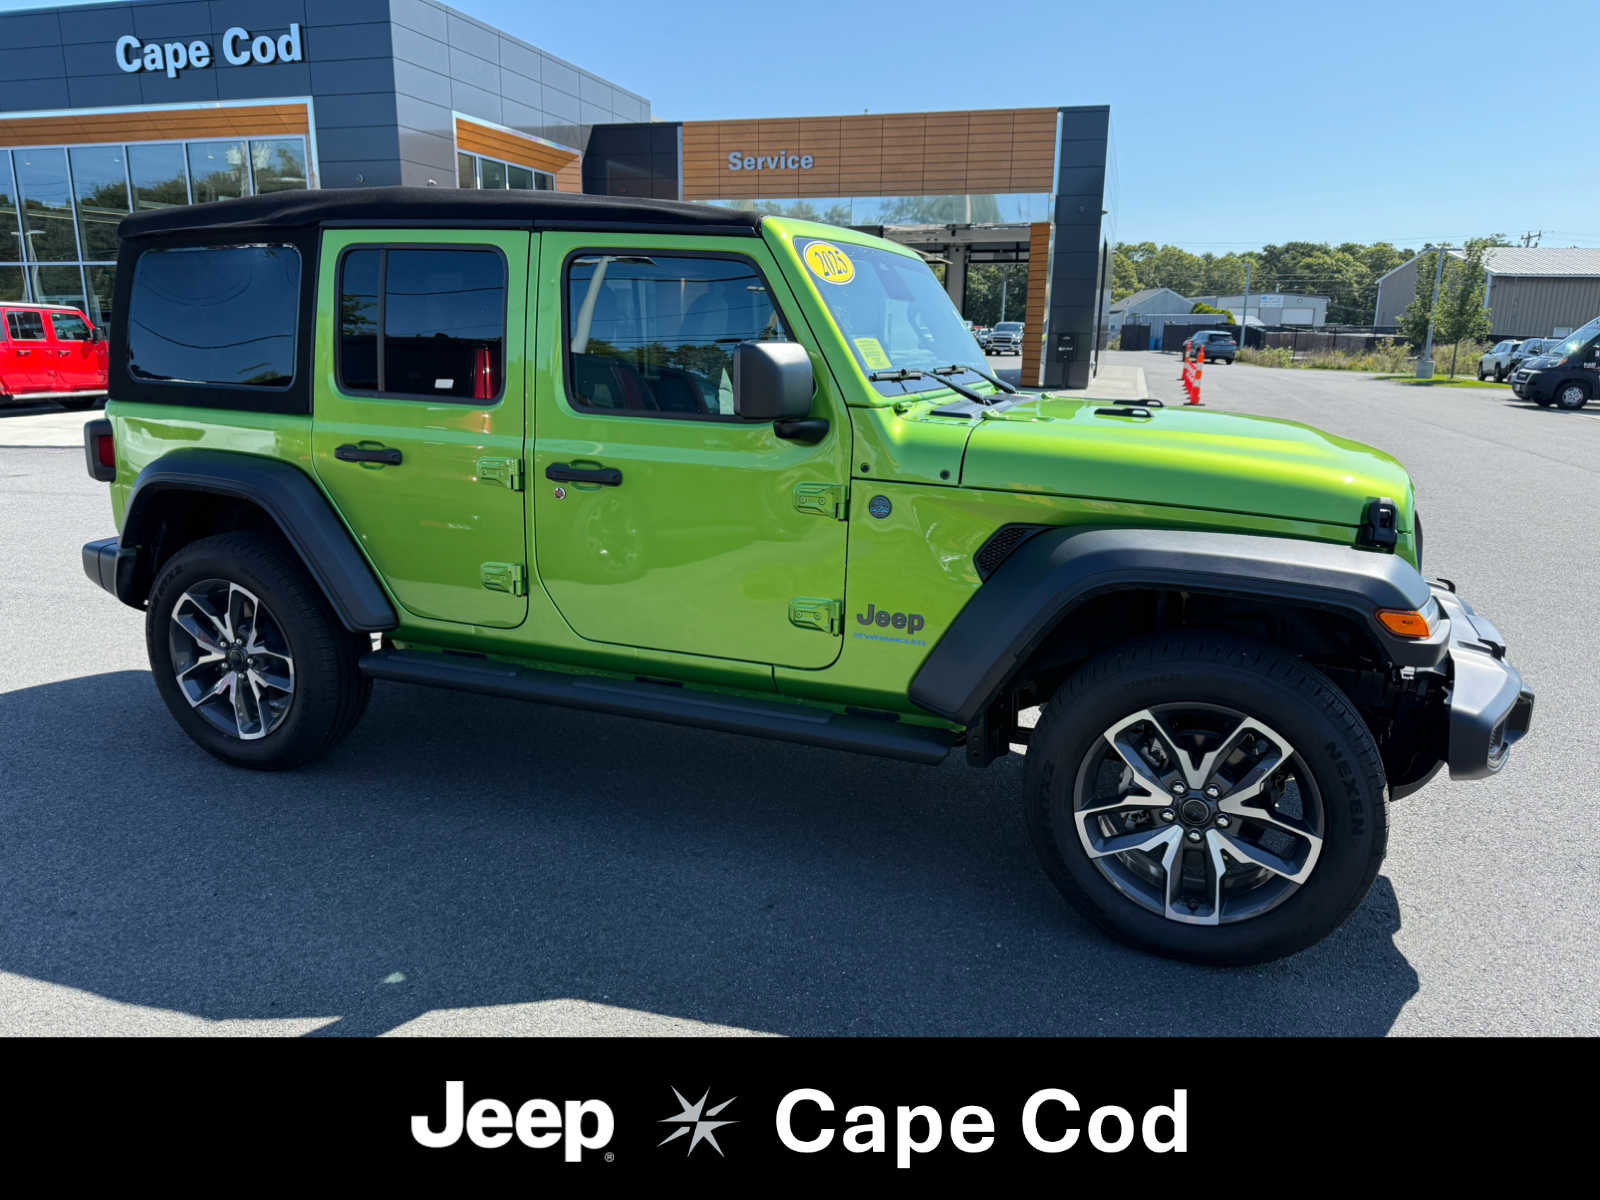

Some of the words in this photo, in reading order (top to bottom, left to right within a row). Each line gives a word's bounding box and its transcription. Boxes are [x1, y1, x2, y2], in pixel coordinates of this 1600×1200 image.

[115, 35, 212, 79] Cape
[221, 23, 303, 67] Cod
[728, 151, 815, 171] Service
[814, 249, 848, 277] 2025
[856, 603, 925, 635] Jeep
[1325, 741, 1364, 835] NEXEN
